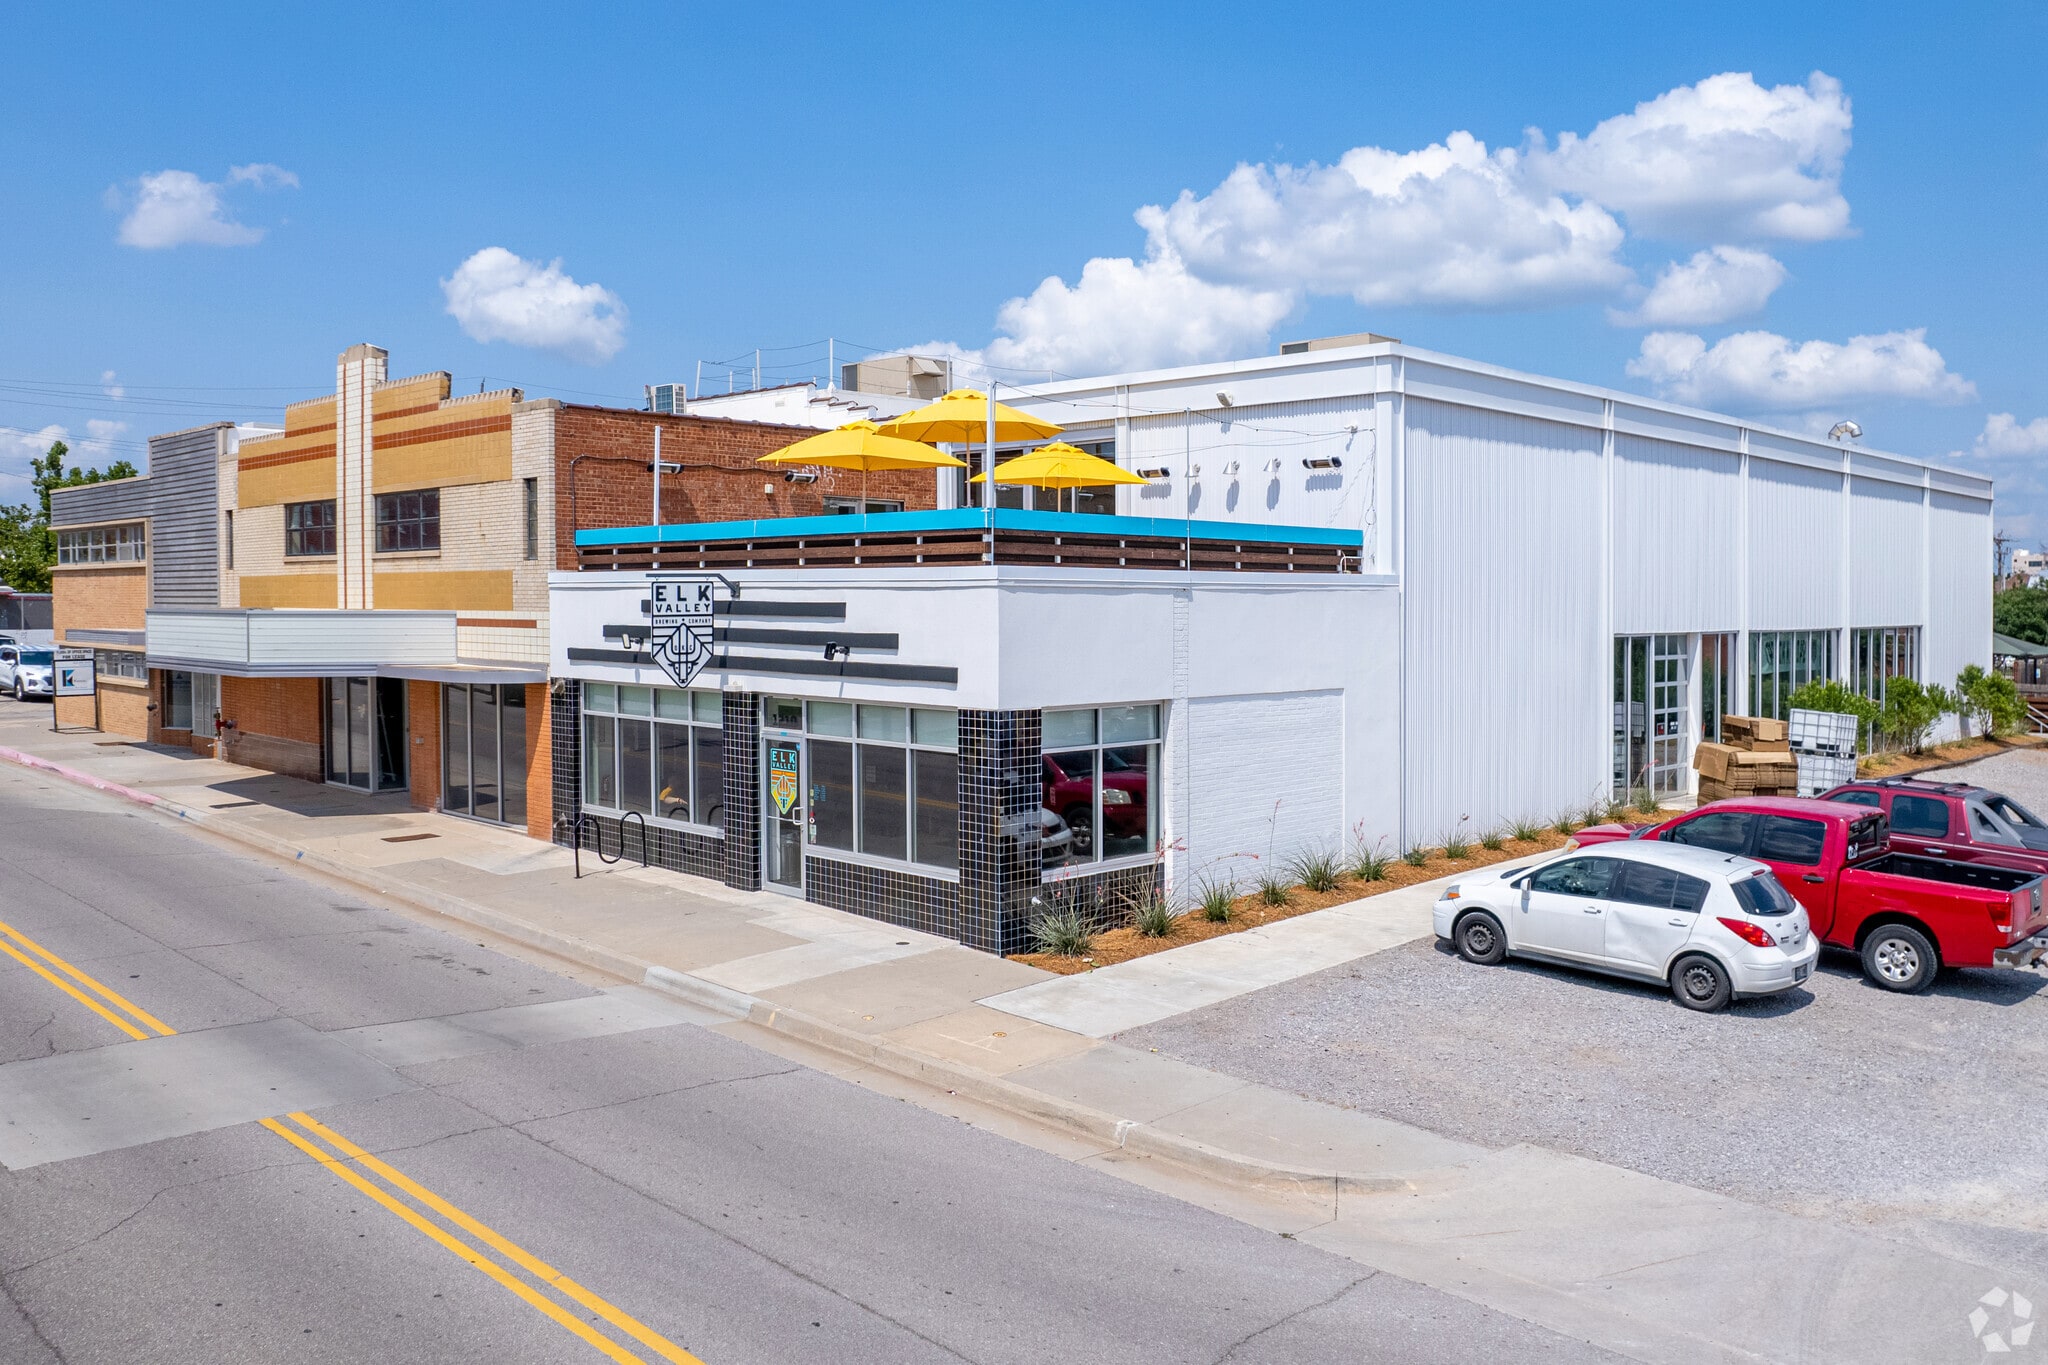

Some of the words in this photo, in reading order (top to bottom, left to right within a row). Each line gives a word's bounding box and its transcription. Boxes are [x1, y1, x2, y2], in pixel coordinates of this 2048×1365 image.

[655, 585, 710, 602] ELK
[655, 603, 710, 613] VALLEY
[772, 750, 795, 764] ELK
[772, 762, 795, 770] VALLEY
